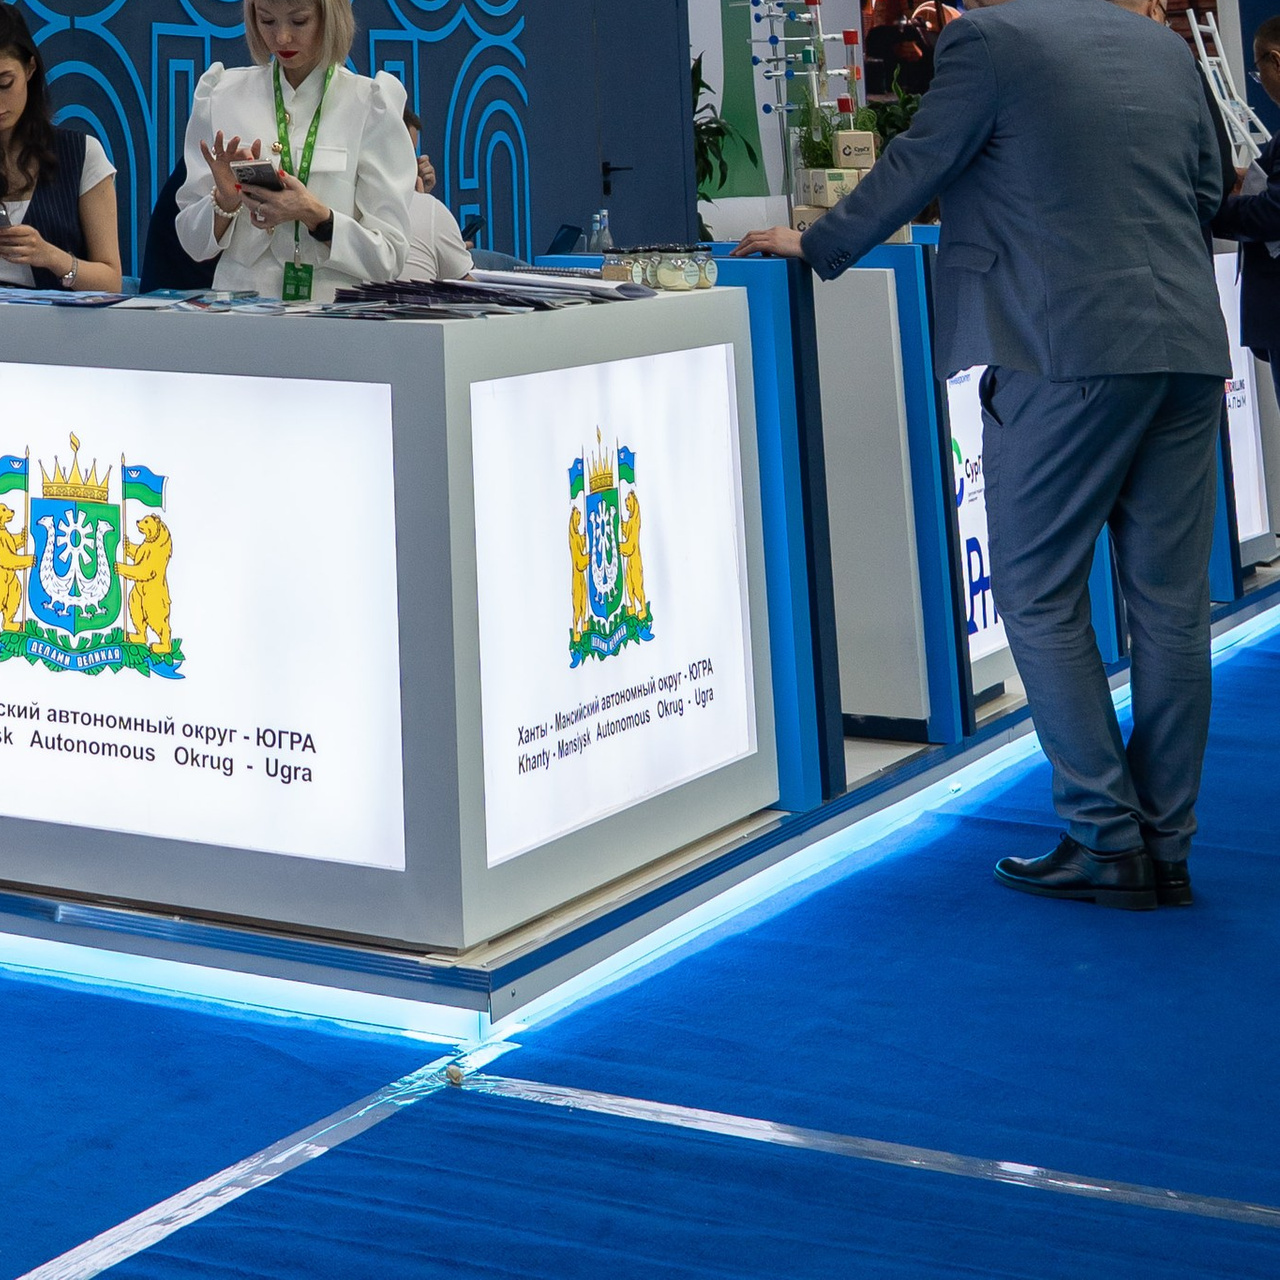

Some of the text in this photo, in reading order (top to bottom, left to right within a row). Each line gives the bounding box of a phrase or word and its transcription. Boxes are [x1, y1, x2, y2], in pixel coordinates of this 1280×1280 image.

[31, 641, 120, 667] ДЕЛАМИ ВЕЛИКАЯ
[517, 722, 548, 746] Ханты
[555, 695, 600, 732] Мансийский
[601, 676, 656, 711] автономный
[658, 670, 682, 692] округ
[689, 657, 714, 681] ЮГРА
[30, 730, 156, 762] Autonomous
[174, 746, 234, 777] Okrug
[265, 757, 312, 784] Ugra
[47, 708, 174, 736] автономный
[182, 723, 237, 747] округ
[256, 727, 317, 754] ЮГРА
[518, 746, 550, 775] Khanty
[558, 728, 592, 760] Mansiysk
[596, 709, 651, 742] Autonomous
[657, 697, 684, 720] Okrug
[695, 687, 714, 708] Ugra
